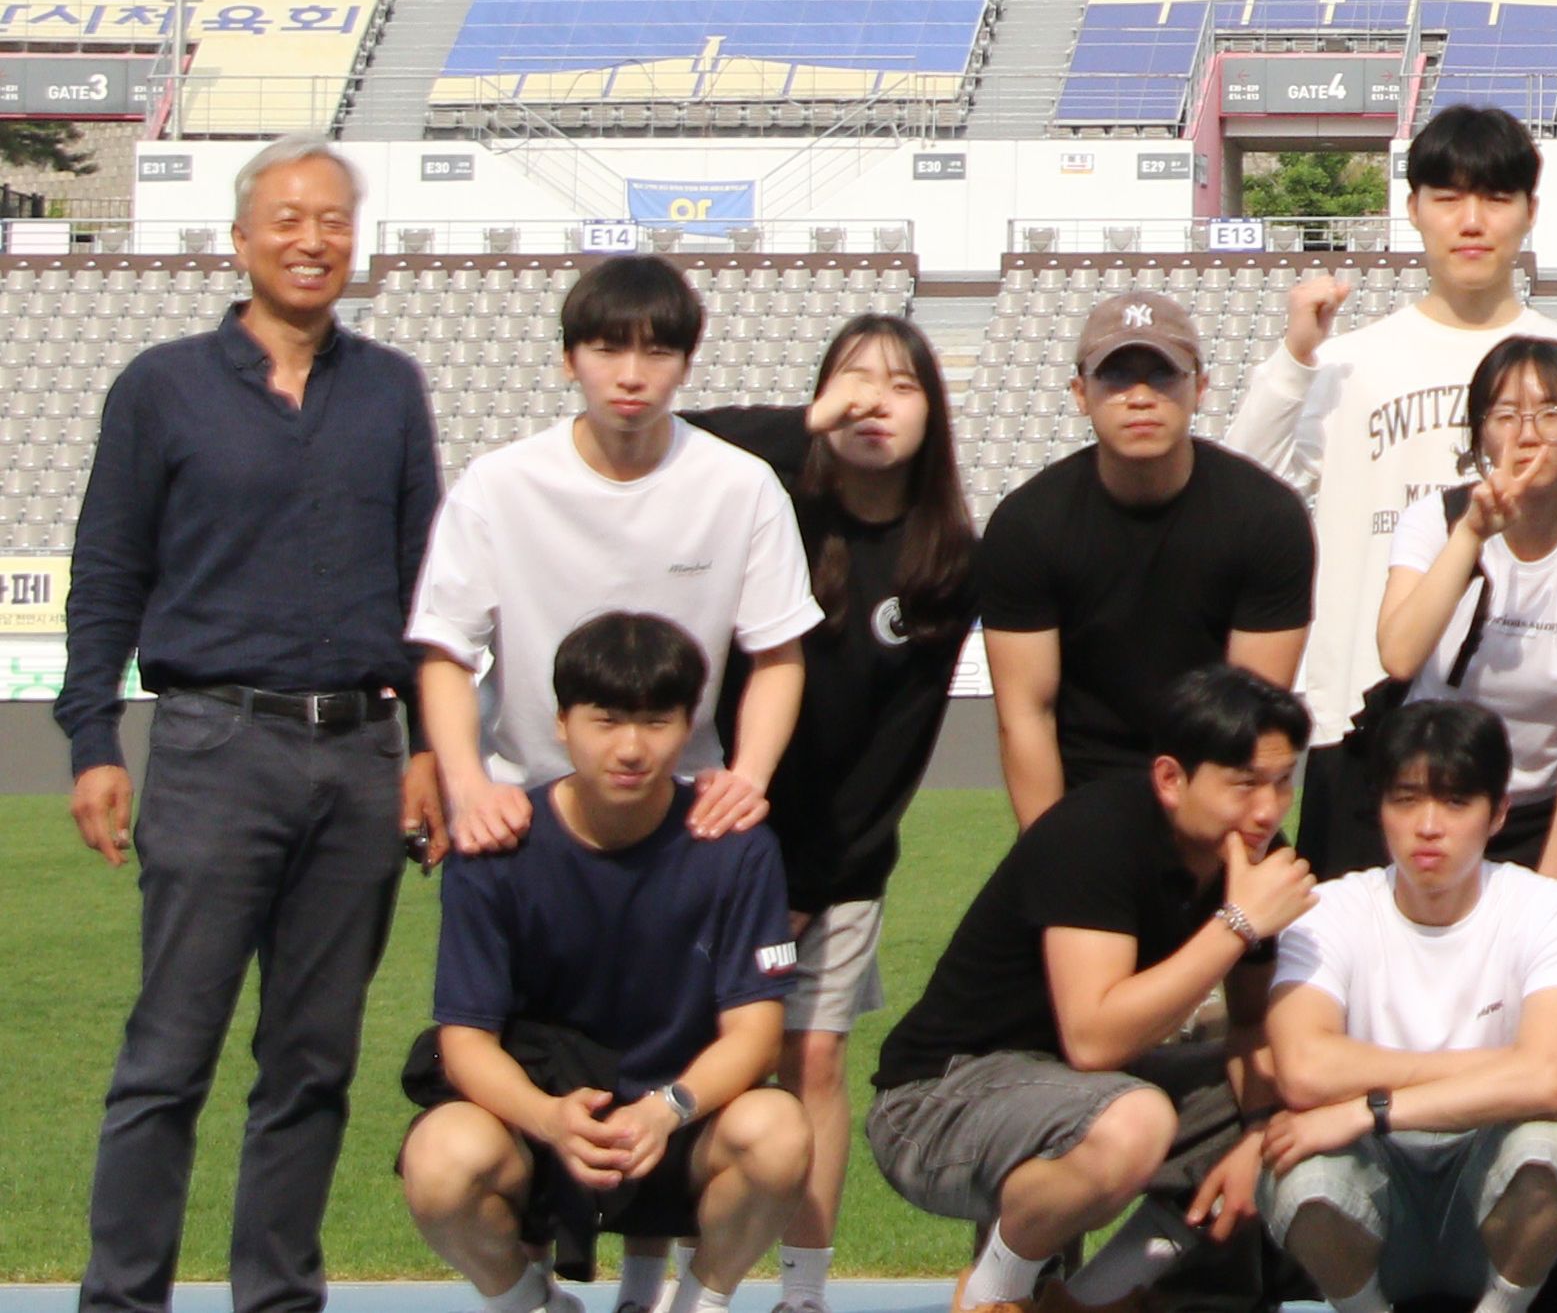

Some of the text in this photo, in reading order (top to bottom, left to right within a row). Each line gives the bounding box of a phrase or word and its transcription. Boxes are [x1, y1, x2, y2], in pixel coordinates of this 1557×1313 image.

[142, 162, 166, 174] E31
[426, 161, 450, 173] E30
[917, 161, 941, 173] E30
[1141, 161, 1166, 173] E29
[590, 228, 631, 246] E14
[1217, 227, 1256, 245] E13
[1368, 384, 1471, 461] SWITZ
